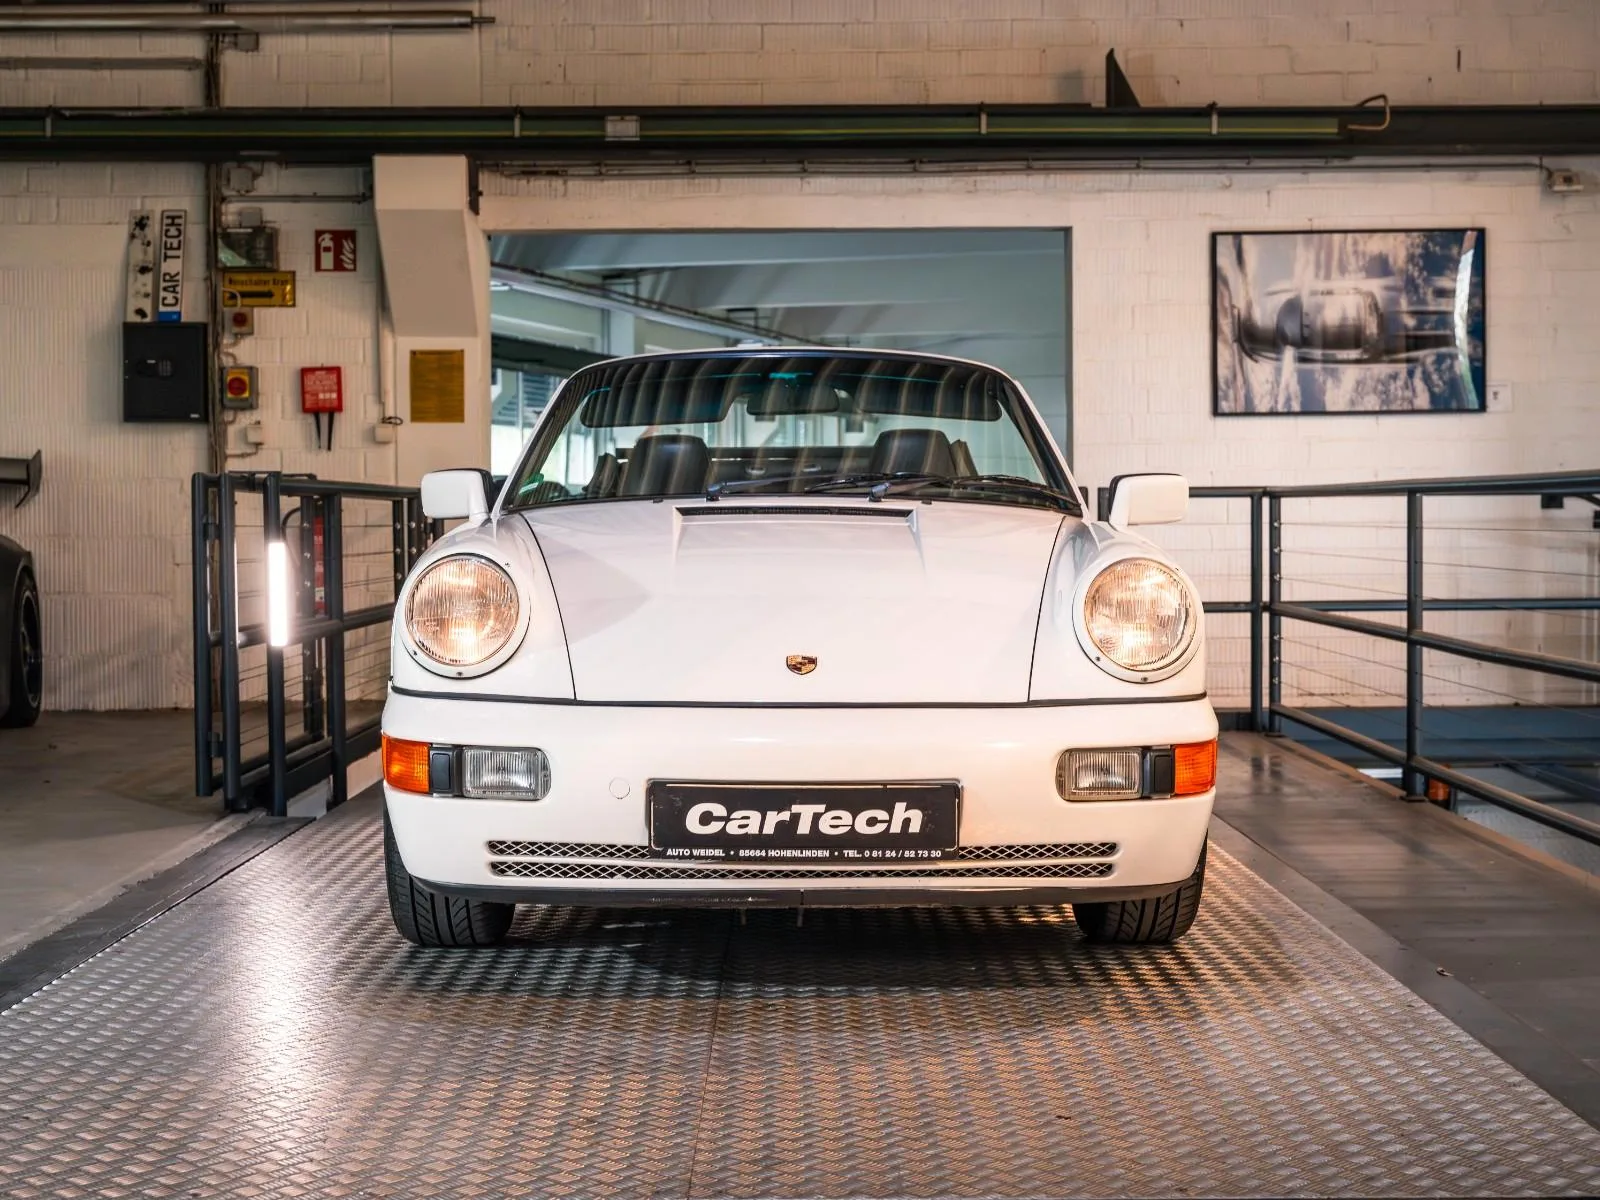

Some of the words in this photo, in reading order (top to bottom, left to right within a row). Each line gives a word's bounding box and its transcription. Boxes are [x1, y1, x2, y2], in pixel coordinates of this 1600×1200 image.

[163, 215, 183, 262] TECH
[162, 271, 180, 307] CAR
[685, 802, 923, 835] CarTech
[666, 848, 691, 856] AUTO
[692, 848, 726, 857] WEIDEL
[739, 849, 766, 857] 85664
[768, 849, 830, 858] HOHENLINDEN
[843, 849, 863, 858] TEL.
[864, 849, 870, 858] 0
[872, 849, 882, 858] 81
[885, 849, 897, 858] 24
[904, 849, 916, 858] 52
[917, 849, 929, 858] 73
[930, 849, 942, 858] 30
